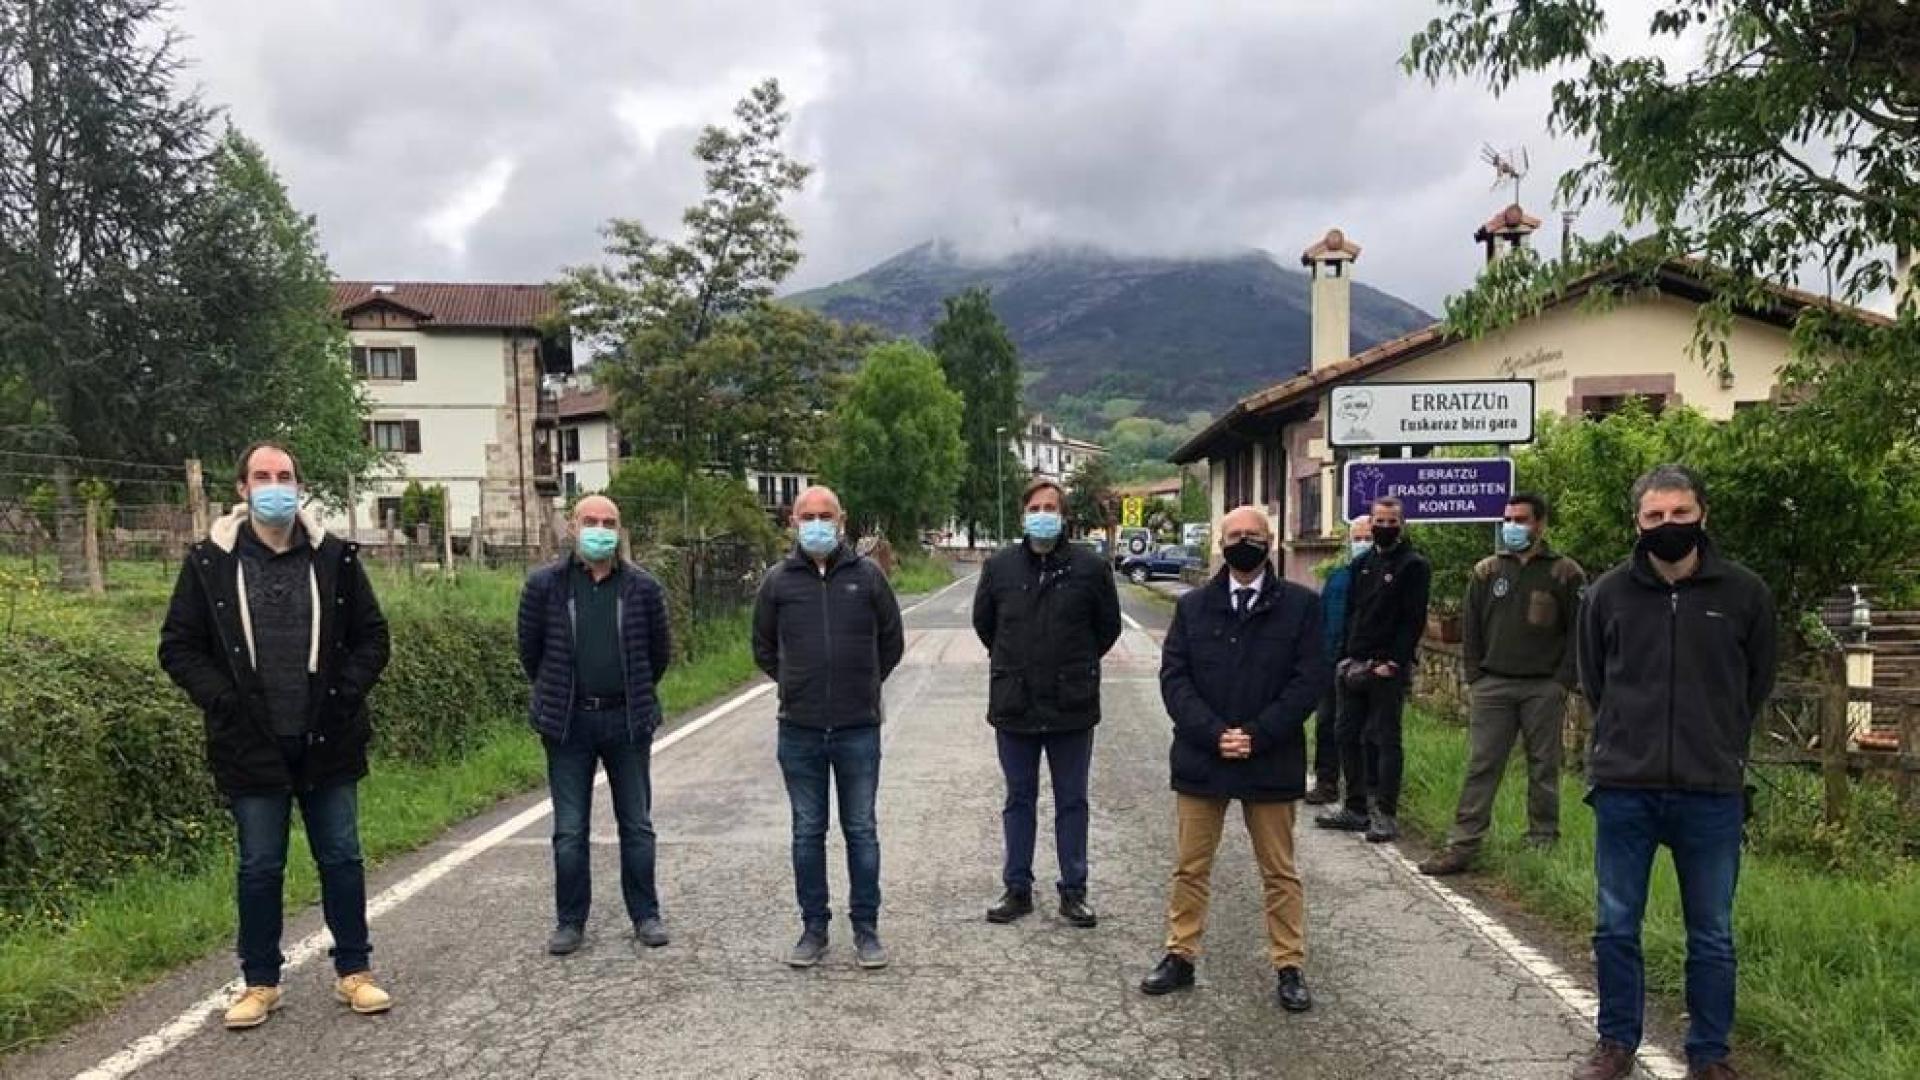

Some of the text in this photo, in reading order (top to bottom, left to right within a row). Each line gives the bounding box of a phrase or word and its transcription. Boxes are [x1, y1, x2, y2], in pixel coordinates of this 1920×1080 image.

[1400, 416, 1517, 432] Euskaraz bizi gara
[1417, 468, 1478, 480] ERRATZU
[1388, 482, 1506, 496] ERASO SEXISTEN
[1418, 500, 1476, 513] KONTRA
